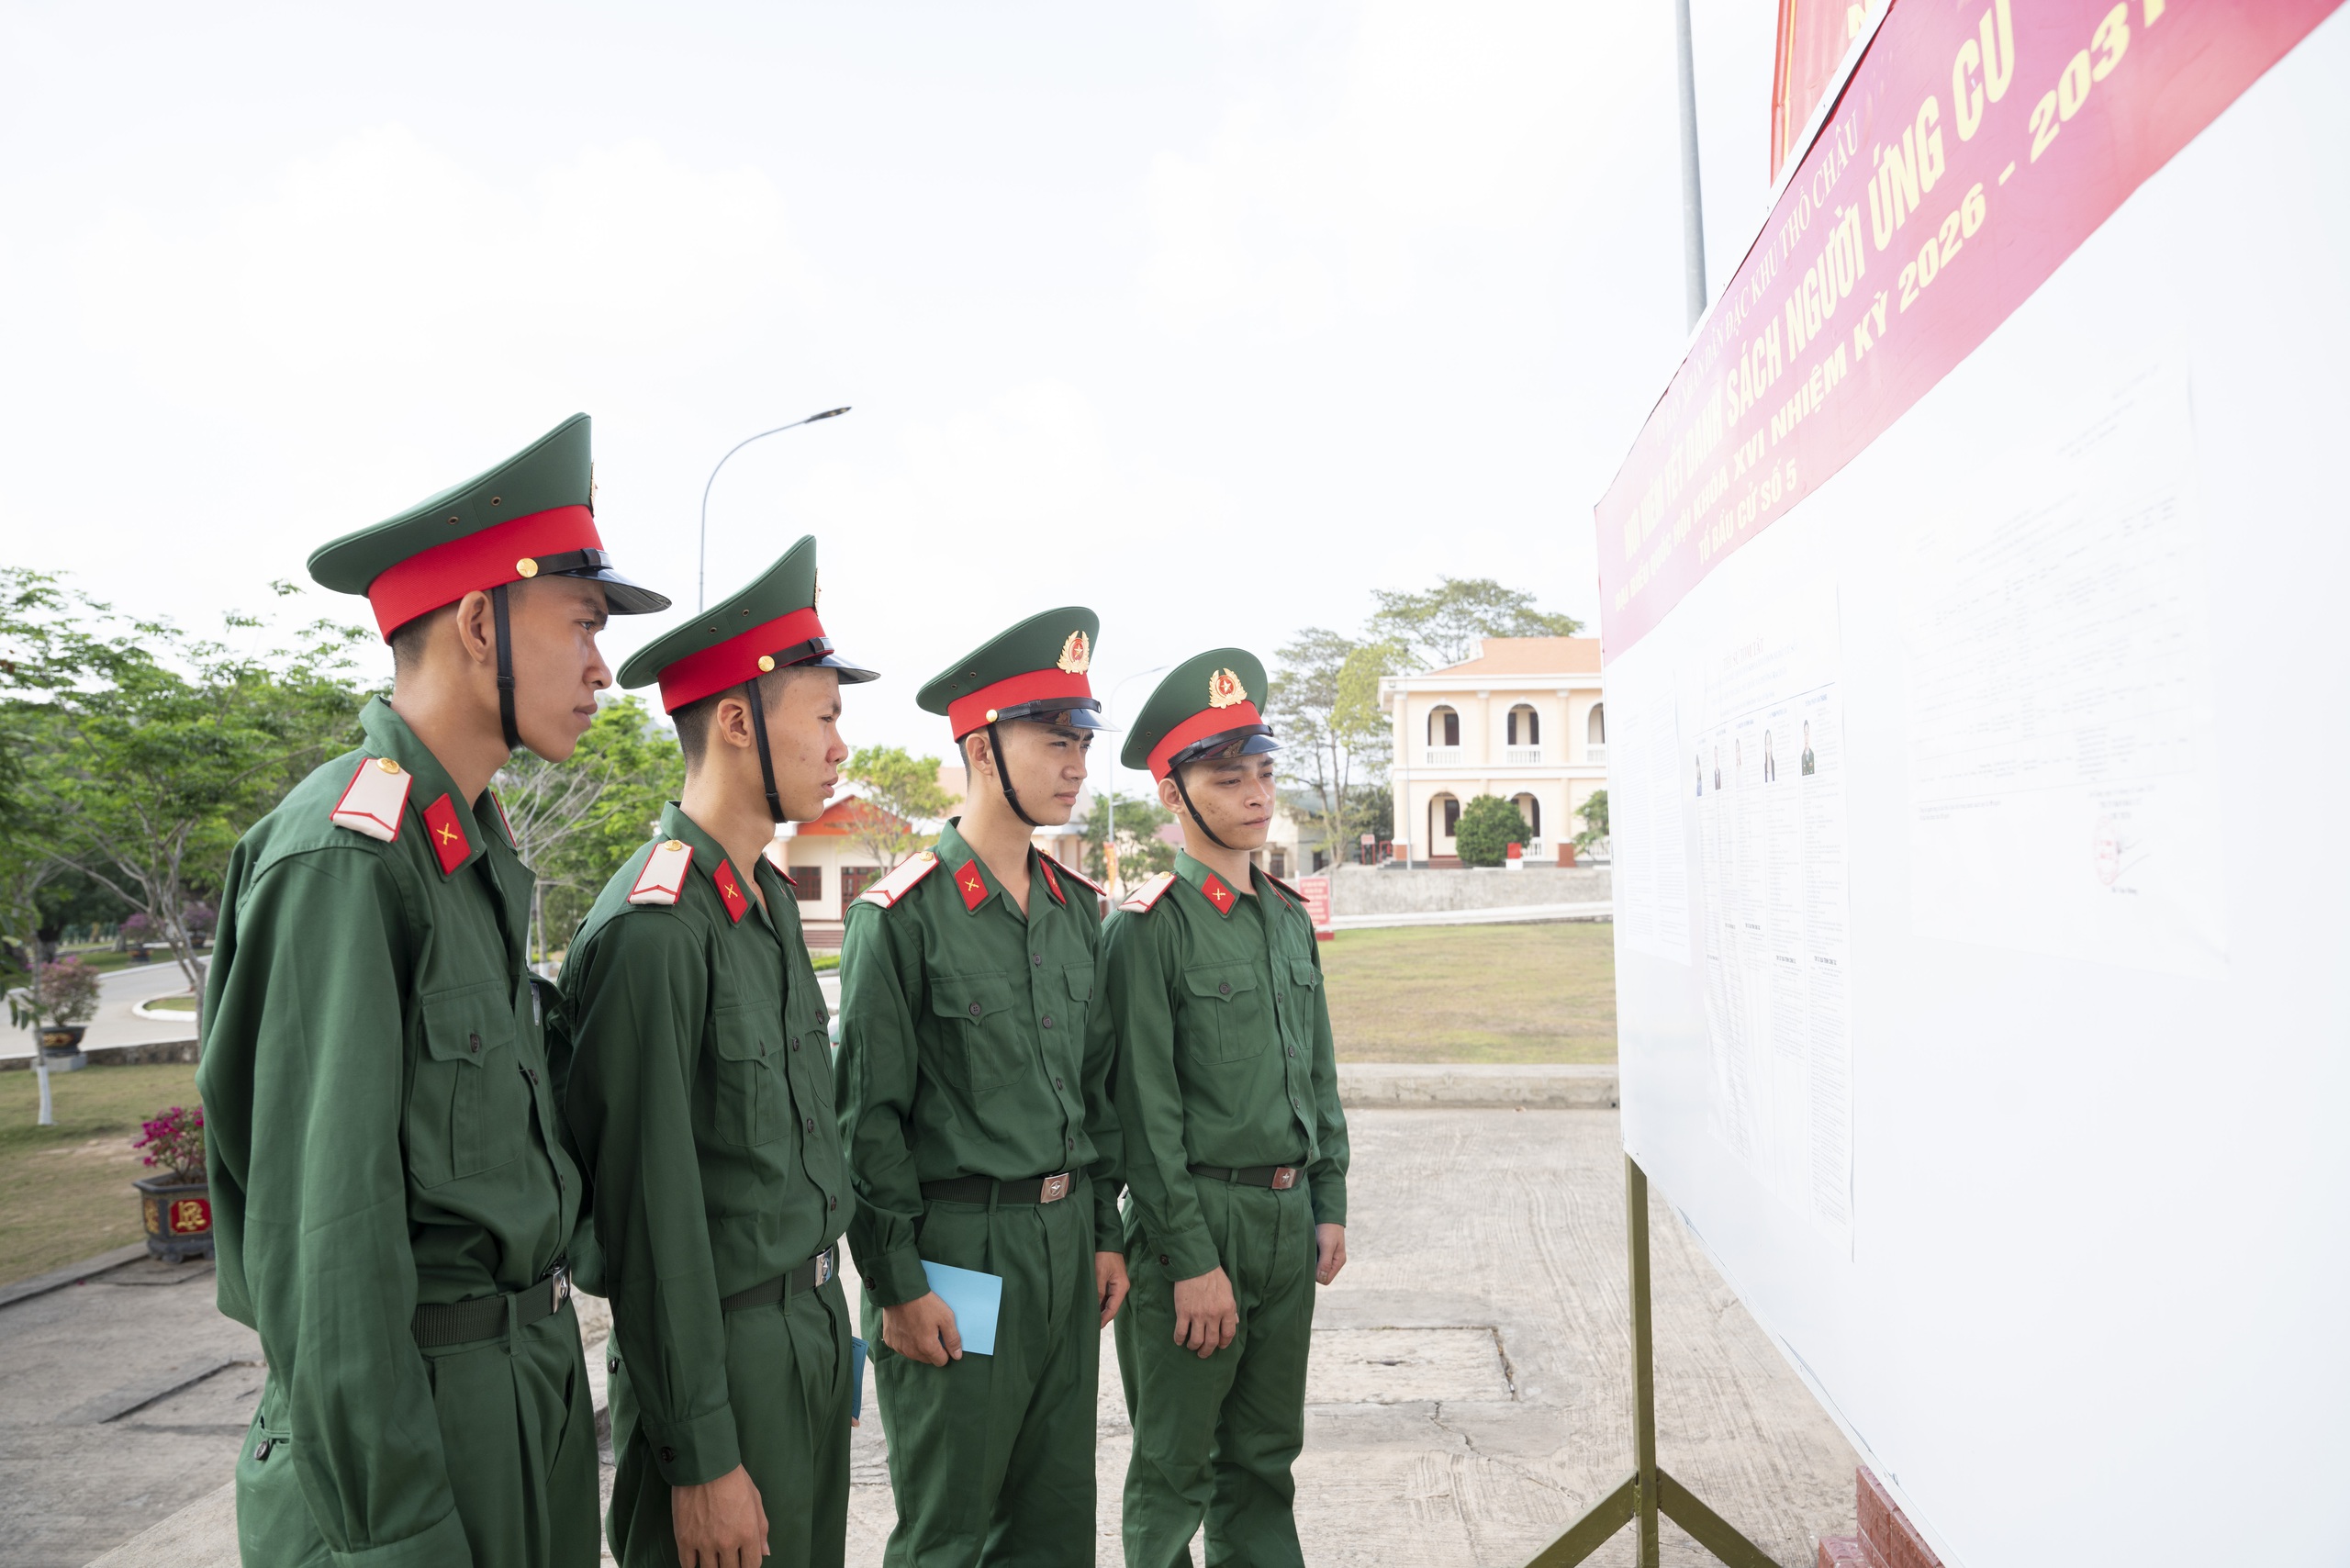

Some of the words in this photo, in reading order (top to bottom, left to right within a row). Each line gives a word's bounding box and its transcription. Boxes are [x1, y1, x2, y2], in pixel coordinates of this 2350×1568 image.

[1616, 583, 1629, 613] ĐẠI
[1629, 558, 1650, 599] BIỂU
[1650, 530, 1672, 577] QUỐC
[1673, 507, 1691, 547] HỘI
[1694, 465, 1729, 524] KHÓA
[1733, 427, 1765, 482] XVI
[1771, 342, 1848, 448] NHIỆM
[1853, 290, 1888, 363] KỲ
[1897, 182, 1986, 314] 2026
[1998, 160, 2016, 186] -
[2029, 0, 2165, 164] 203
[1664, 431, 1683, 507] YẾT
[1686, 386, 1722, 481] DANH
[1727, 315, 1783, 428] SÁCH
[1785, 202, 1865, 364] NGƯỜI
[1867, 95, 1945, 252] ỨNG
[1706, 322, 1724, 372] DÂN
[1726, 286, 1750, 343] ĐẶC
[1751, 241, 1779, 307] KHU
[1779, 185, 1810, 262] THỔ
[1813, 109, 1859, 209] CHÂU
[1698, 522, 1710, 566] TỔ
[1712, 509, 1734, 554] BẦU
[1737, 481, 1758, 531] CỬ
[1761, 457, 1782, 512] SỐ
[1785, 457, 1797, 492] 5
